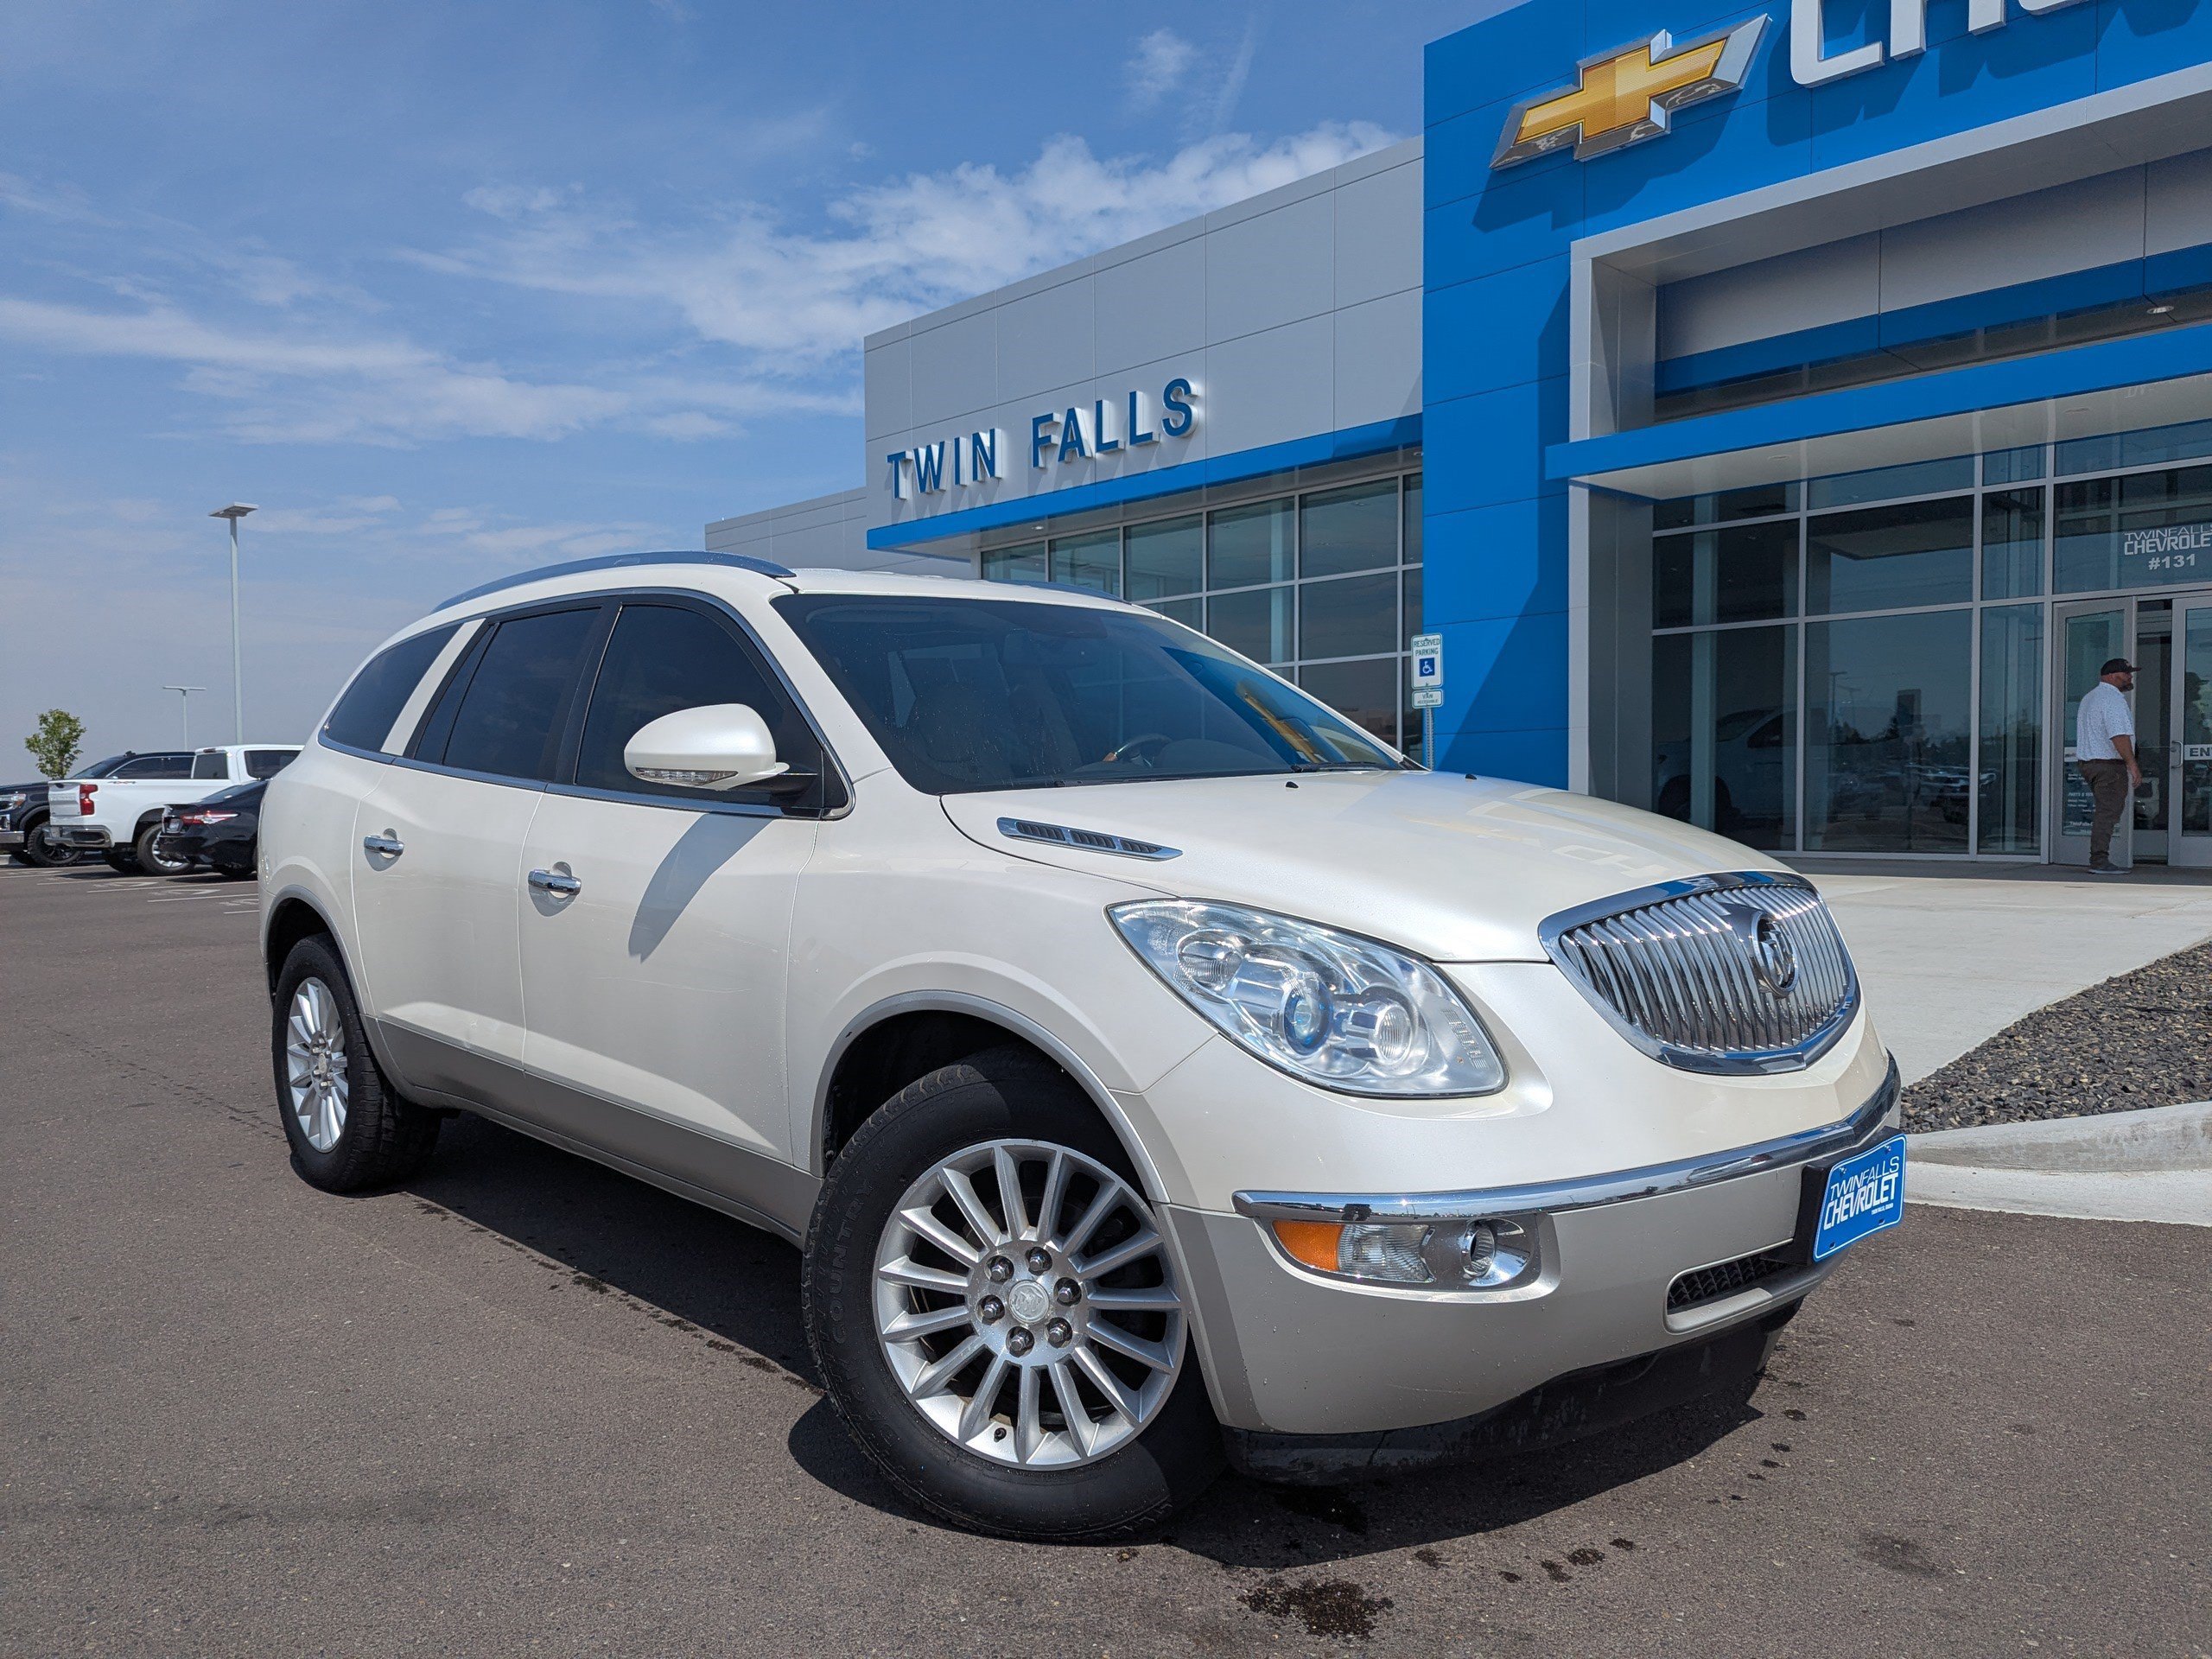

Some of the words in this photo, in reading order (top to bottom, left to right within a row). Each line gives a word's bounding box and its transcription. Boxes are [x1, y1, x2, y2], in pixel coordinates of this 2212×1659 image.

[887, 428, 1002, 500] TWIN
[1032, 378, 1200, 469] FALLS
[2125, 524, 2212, 541] TWINFALL
[2124, 532, 2212, 556] CHEVROLE
[2148, 554, 2196, 570] #131
[1413, 638, 1440, 648] RESERVED
[1414, 647, 1439, 657] PARKING
[2189, 747, 2212, 758] EN
[1823, 1173, 1899, 1231] CHEVROLET
[829, 1177, 874, 1344] COUNTRY
